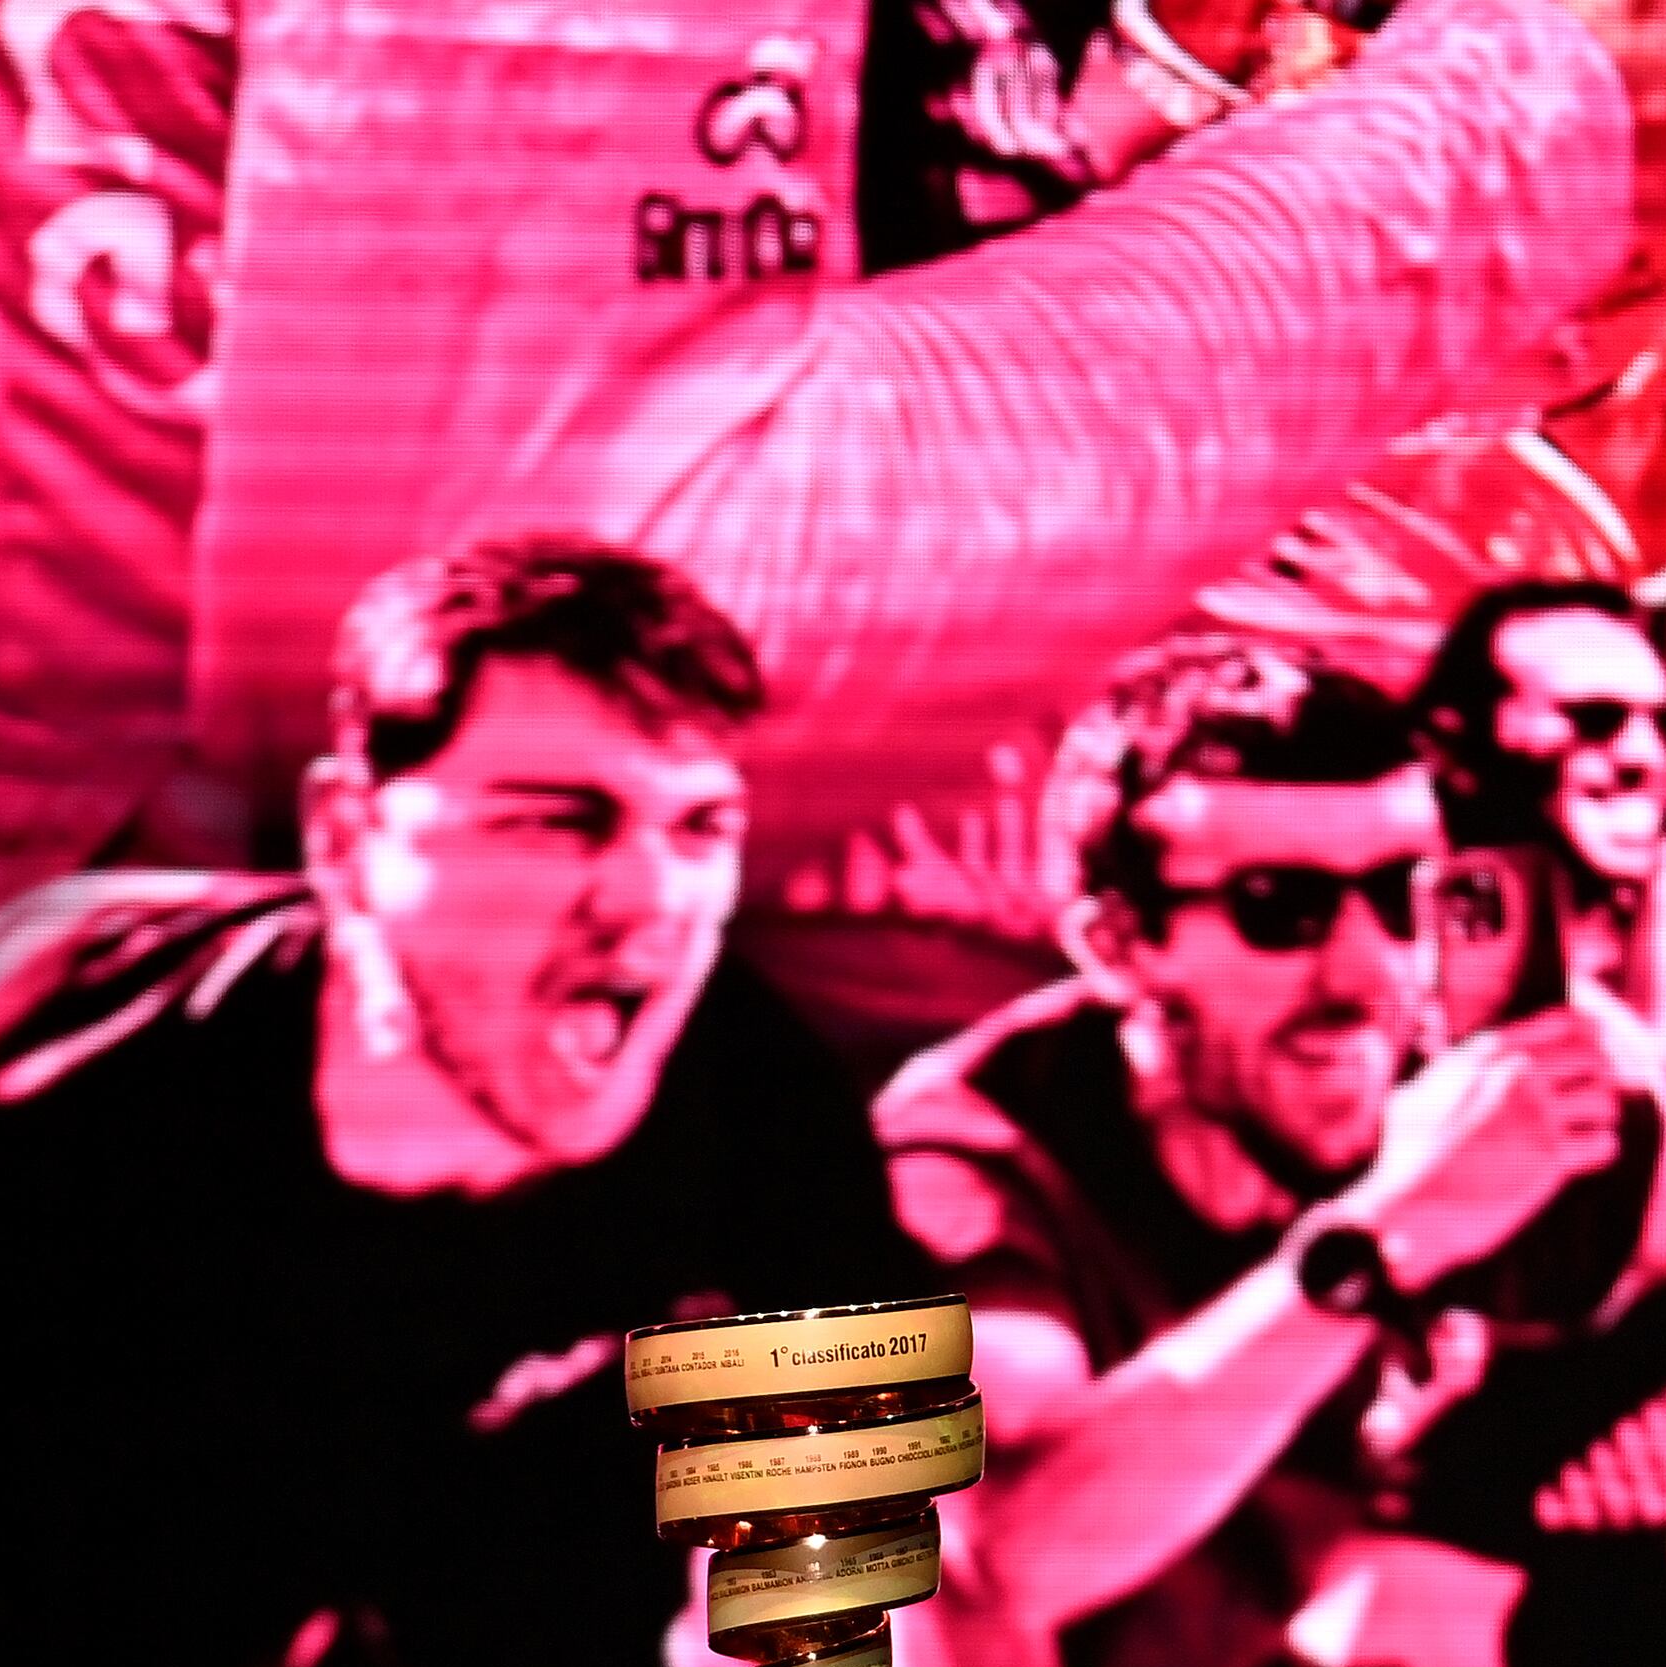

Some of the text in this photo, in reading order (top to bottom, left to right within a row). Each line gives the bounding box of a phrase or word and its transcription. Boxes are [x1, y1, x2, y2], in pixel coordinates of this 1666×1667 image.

[791, 1340, 886, 1366] classificato
[889, 1333, 927, 1356] 2017
[681, 1361, 717, 1372] CONTADOR
[766, 1466, 792, 1478] ROCHE
[839, 1458, 867, 1470] FIGNON
[870, 1455, 896, 1467] BUGNO
[836, 1565, 864, 1578] ADORNI
[866, 1560, 890, 1573] MOTTA
